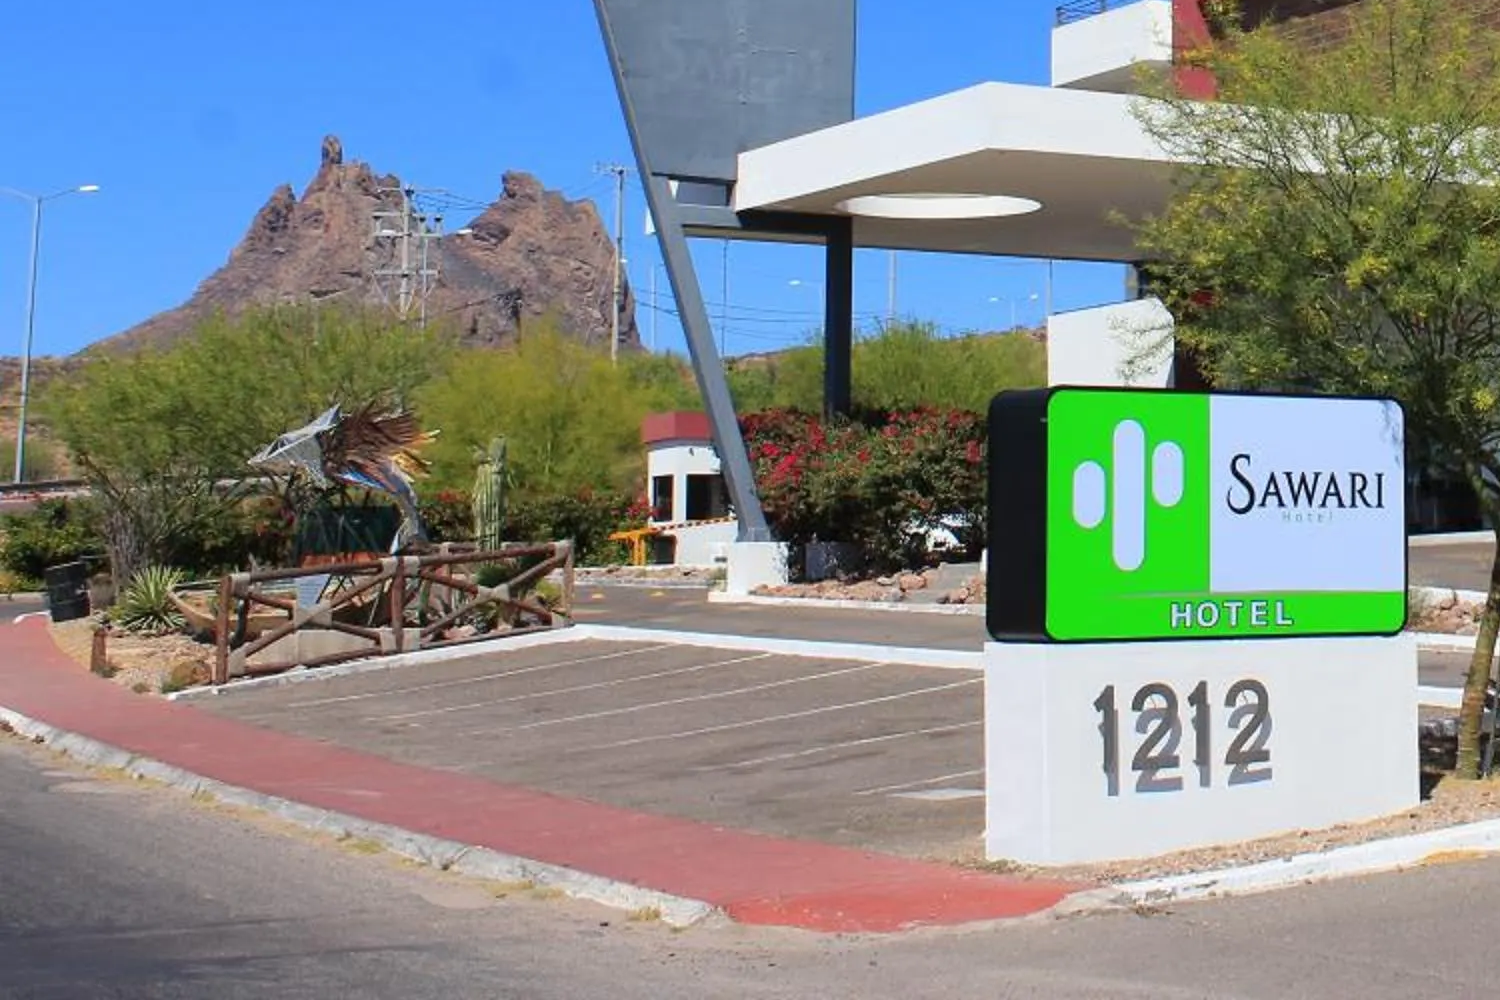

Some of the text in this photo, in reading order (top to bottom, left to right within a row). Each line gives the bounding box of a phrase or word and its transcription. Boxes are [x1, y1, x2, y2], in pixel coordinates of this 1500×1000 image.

[1226, 453, 1385, 514] SAWARI
[1170, 600, 1294, 629] HOTEL
[1093, 678, 1270, 777] 1212
